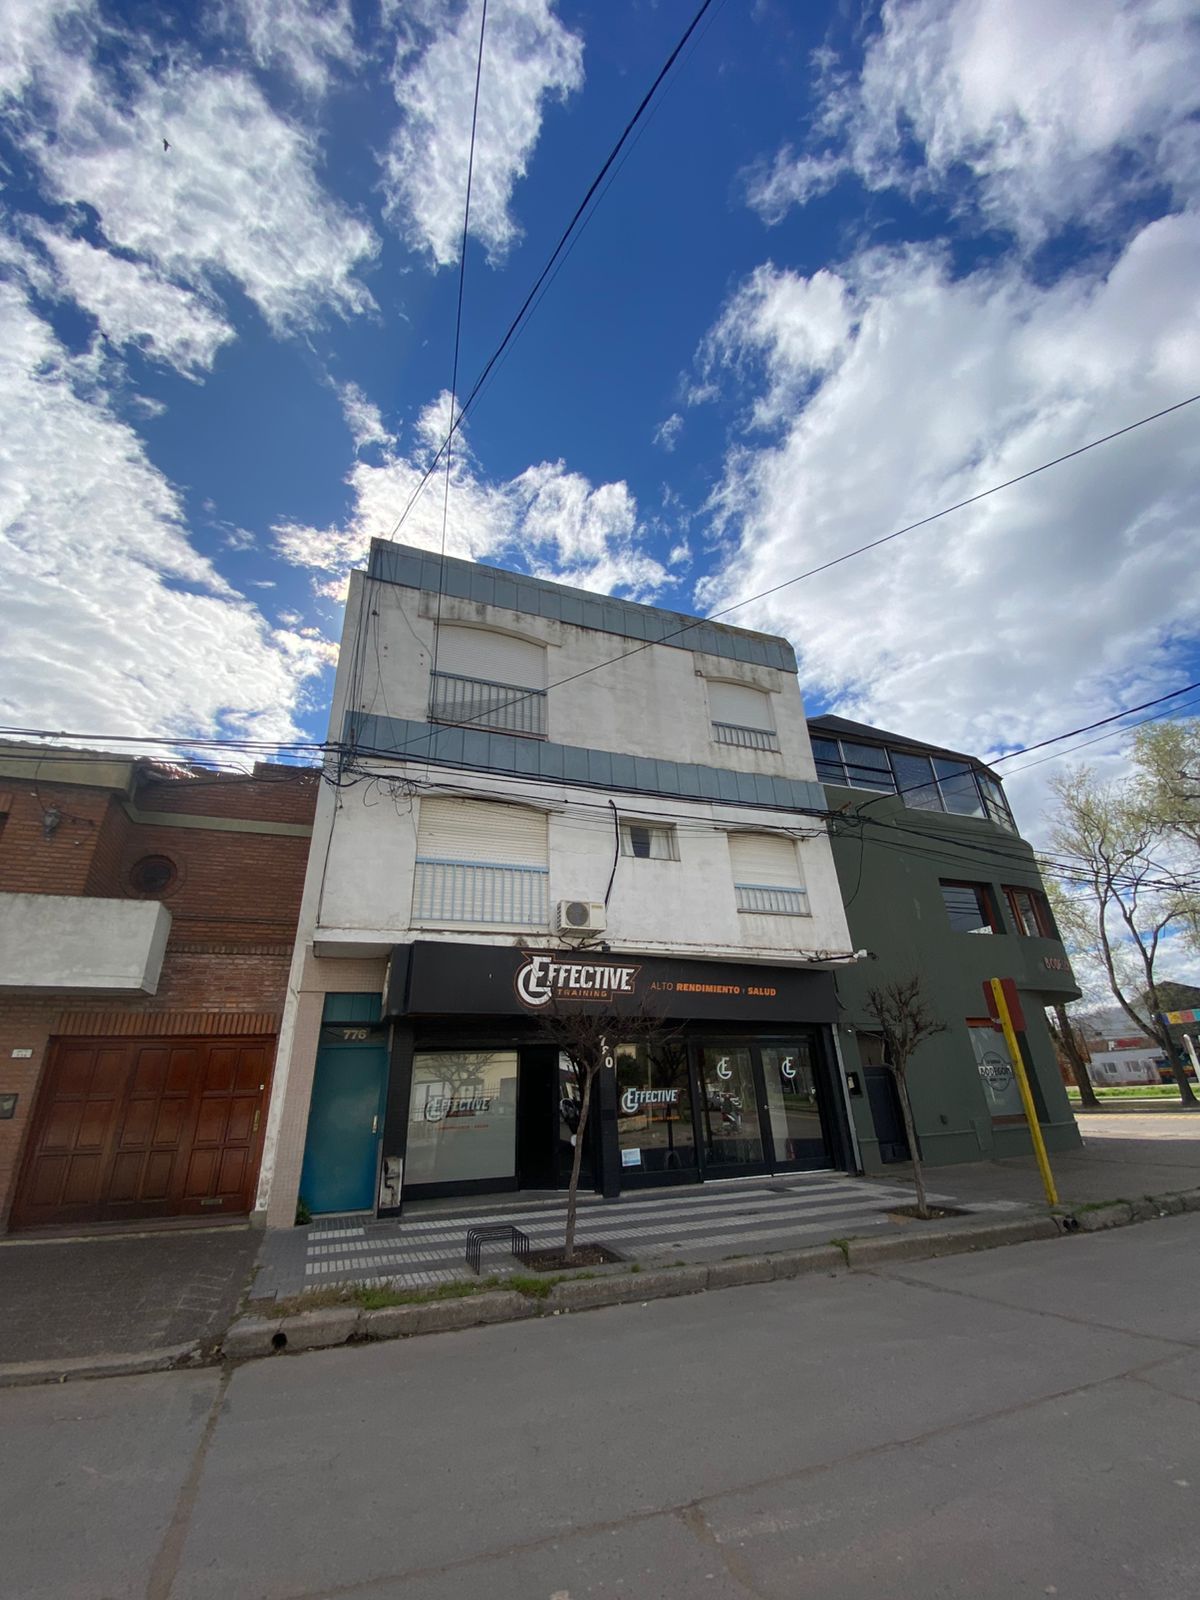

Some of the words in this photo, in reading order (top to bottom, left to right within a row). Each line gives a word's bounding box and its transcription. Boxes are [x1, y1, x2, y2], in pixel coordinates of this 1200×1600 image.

[518, 956, 635, 1004] EFFECTIVE
[557, 988, 608, 998] TRAINING
[651, 982, 674, 991] ALTO
[676, 983, 740, 994] RENDIMIENTO
[747, 987, 776, 996] SALUD
[343, 1030, 367, 1040] 776
[622, 1088, 678, 1112] EFFECTIVE
